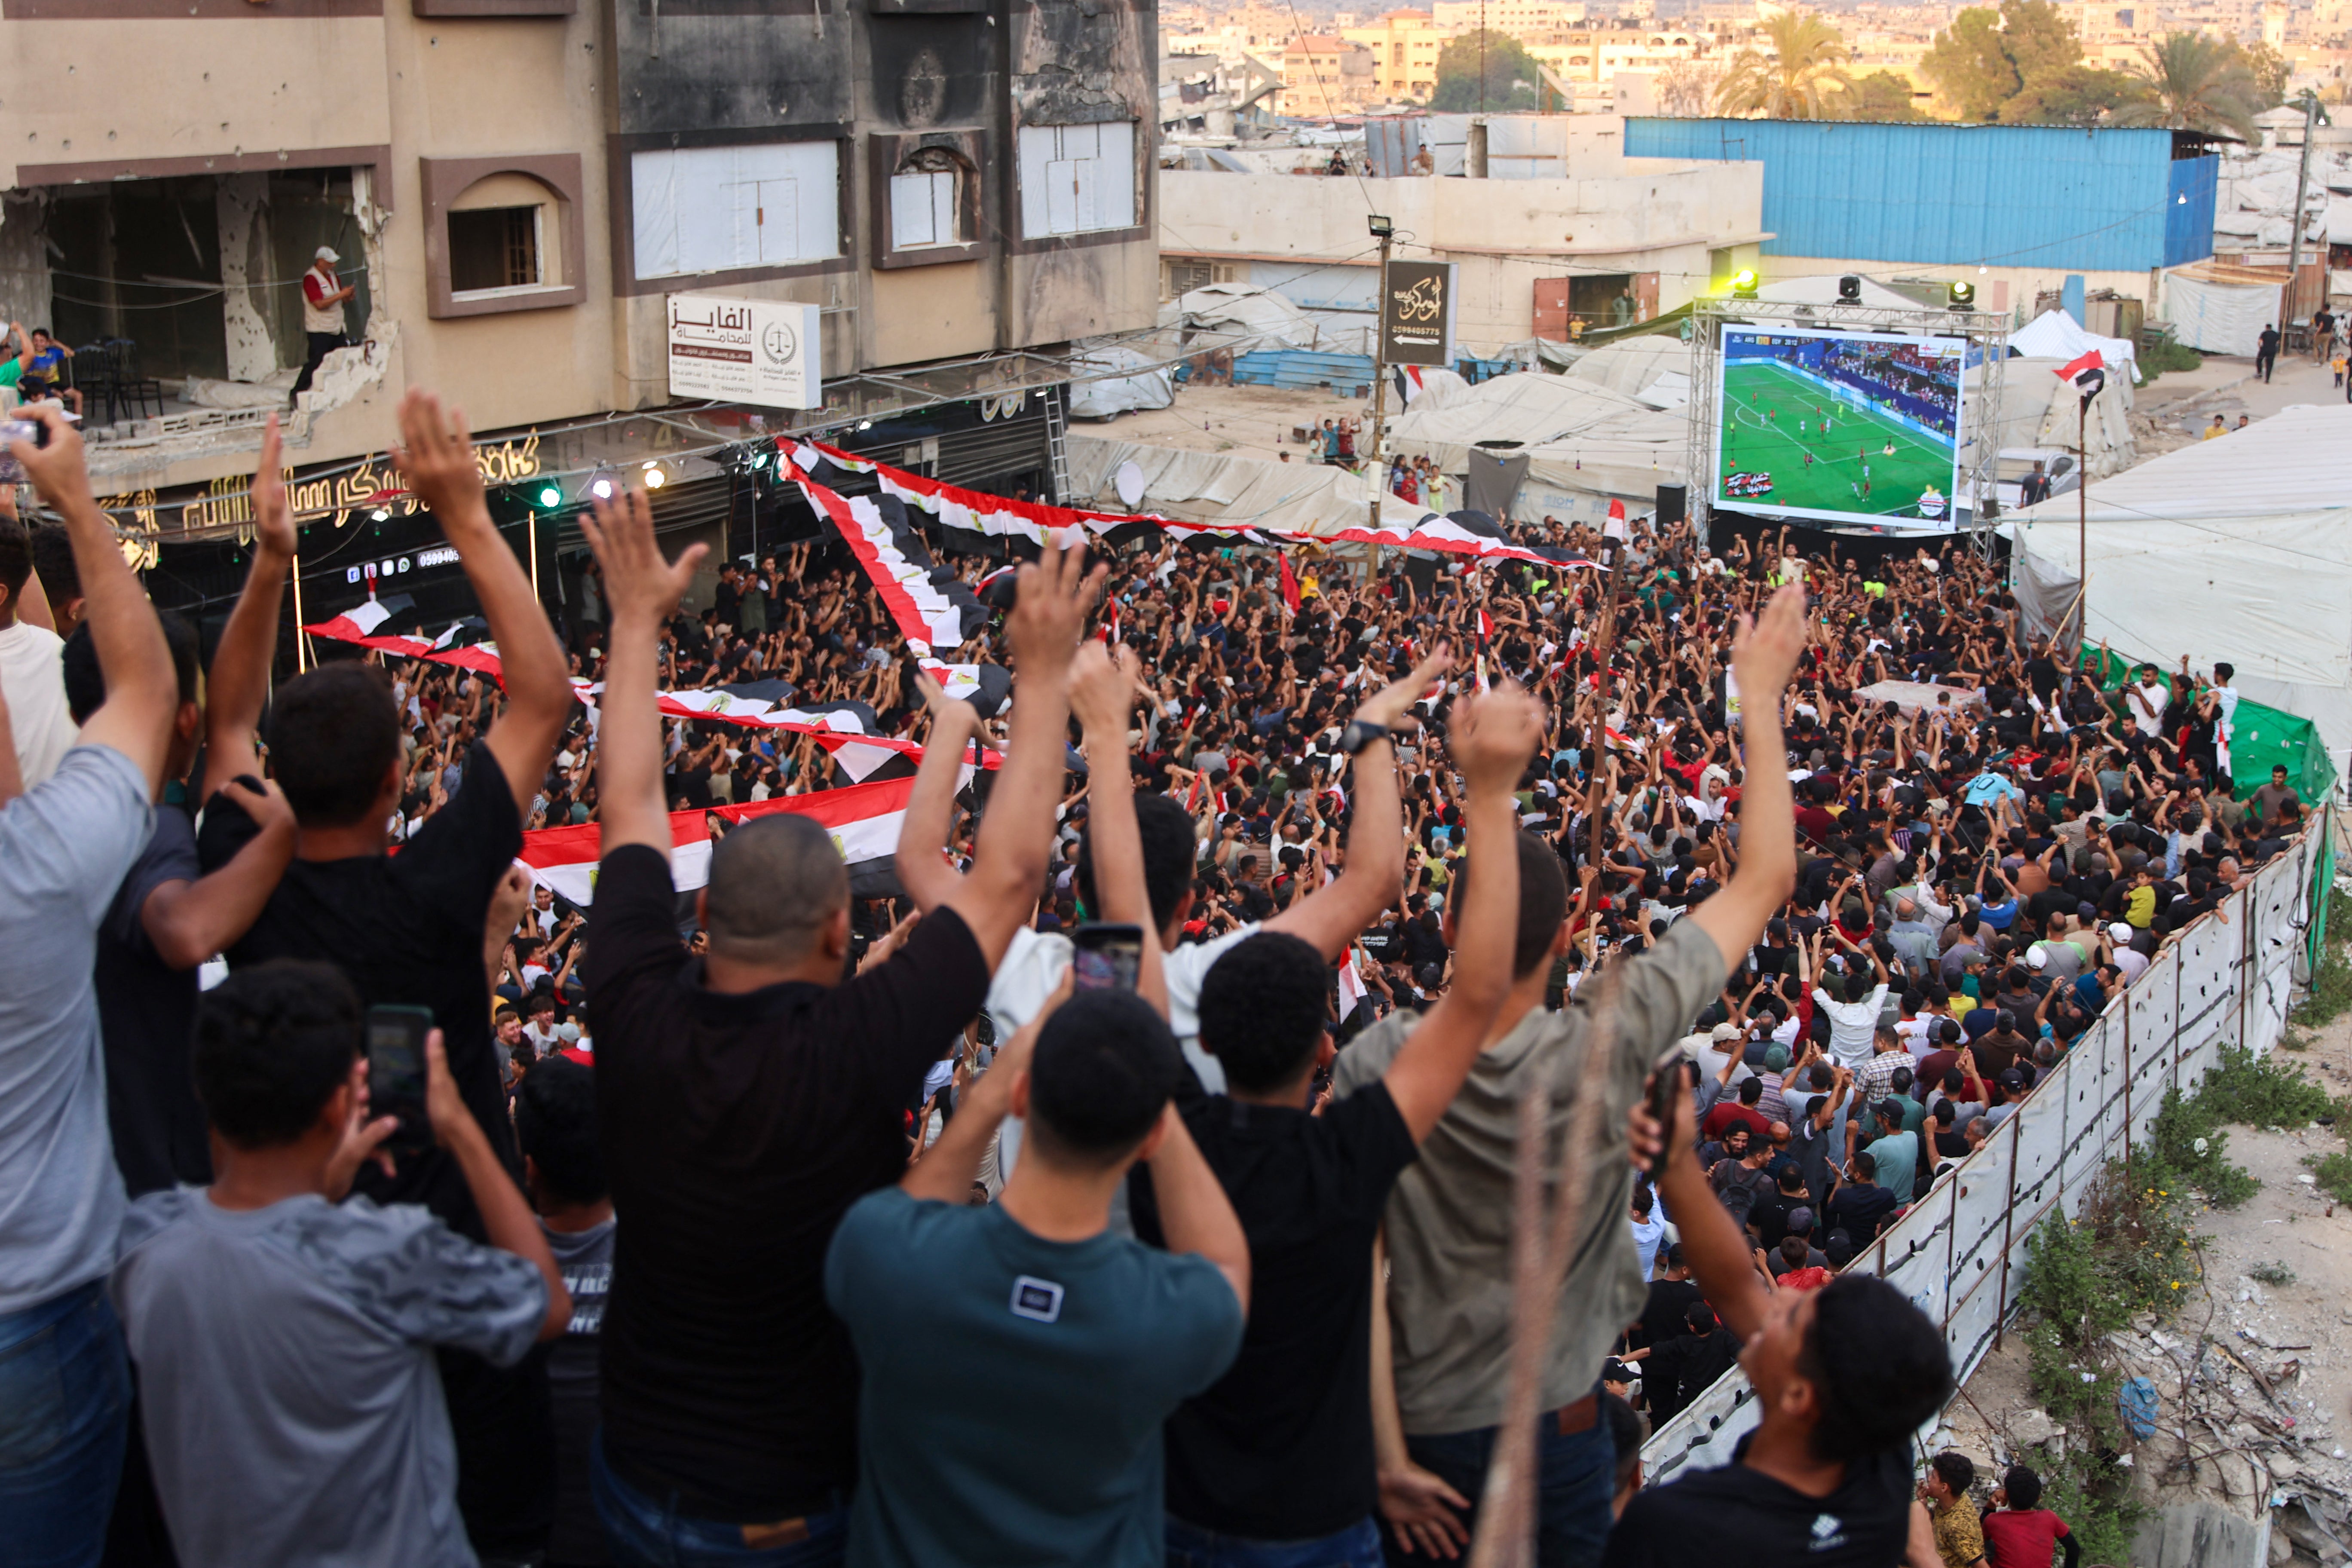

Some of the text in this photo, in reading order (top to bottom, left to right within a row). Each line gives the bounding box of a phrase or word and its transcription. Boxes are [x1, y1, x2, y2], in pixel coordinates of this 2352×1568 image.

[672, 302, 751, 334] الفايز
[677, 328, 751, 344] للمحاماة
[1946, 414, 1956, 422] FIFA
[1553, 498, 1574, 508] IOM
[420, 549, 462, 567] 0599405
[1881, 1003, 1899, 1012] ends
